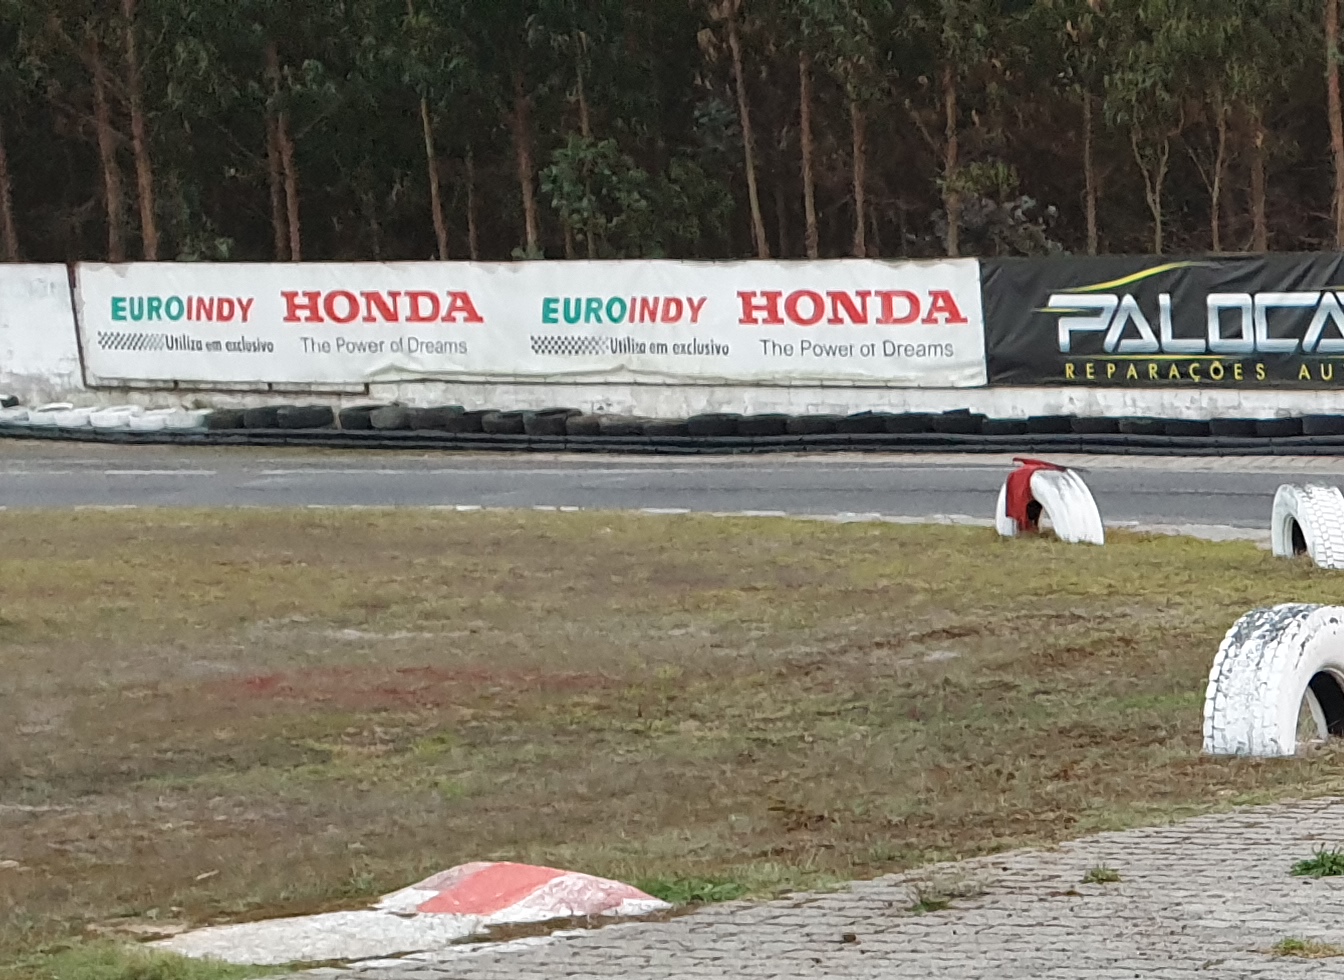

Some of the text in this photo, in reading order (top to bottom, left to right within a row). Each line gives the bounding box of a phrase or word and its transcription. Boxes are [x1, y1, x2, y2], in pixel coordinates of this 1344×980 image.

[111, 295, 255, 323] EUROINDY
[281, 289, 485, 324] HONDA
[541, 295, 709, 324] EUROINDY
[736, 288, 969, 326] HONDA
[205, 341, 222, 352] em
[225, 336, 275, 353] exclusivo
[300, 337, 331, 354] The
[336, 337, 385, 354] Power
[407, 337, 468, 355] Dreams
[650, 342, 668, 355] em
[672, 338, 730, 356] exclusivo
[759, 340, 794, 357] The
[800, 340, 853, 358] Power
[882, 340, 954, 358] Dreams
[1065, 360, 1267, 382] REPARAÇÕES
